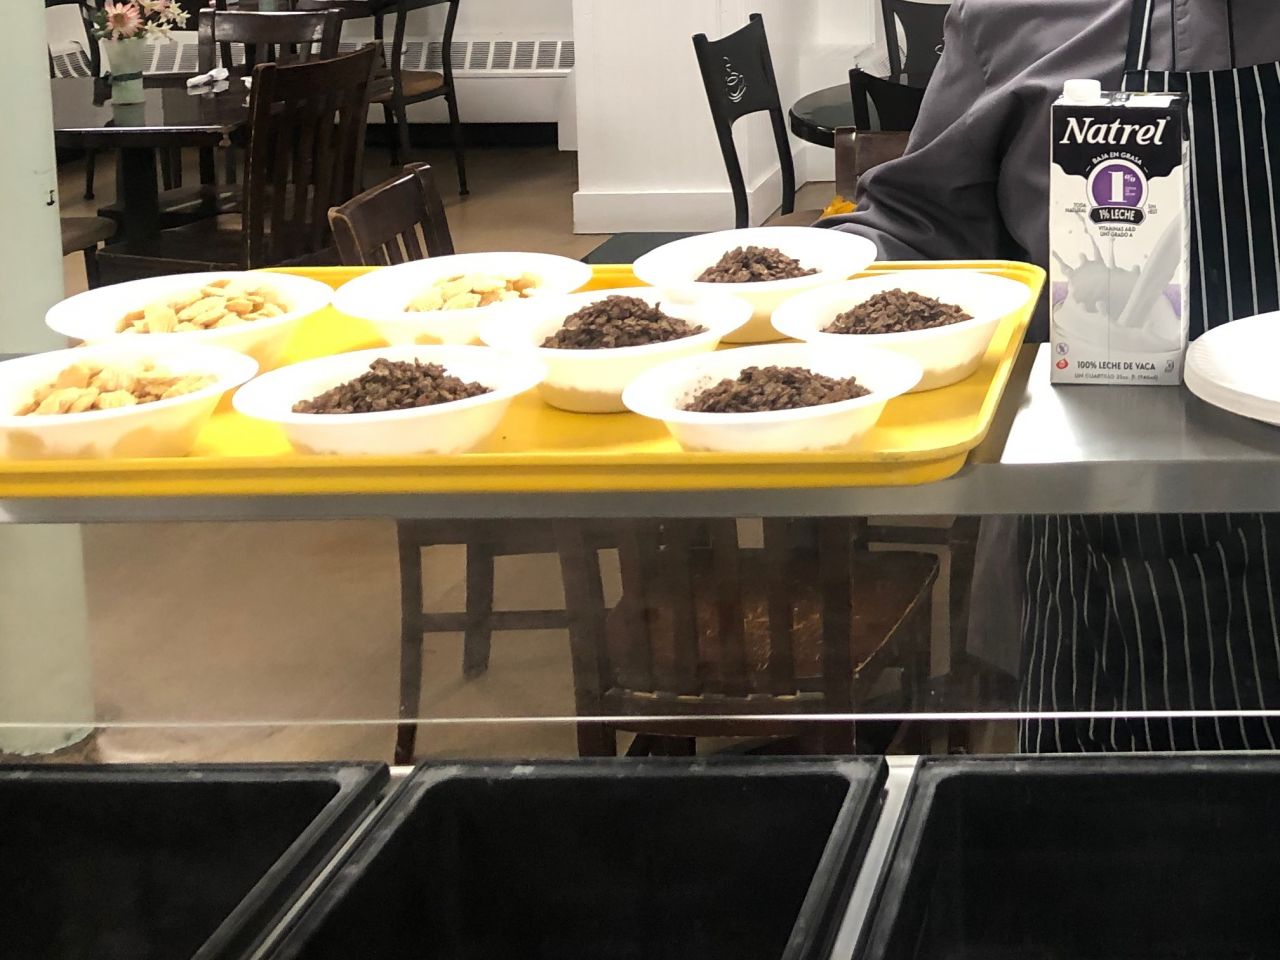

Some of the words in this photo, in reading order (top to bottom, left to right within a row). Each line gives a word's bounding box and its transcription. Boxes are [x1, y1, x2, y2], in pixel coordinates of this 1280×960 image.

[1059, 117, 1167, 145] Natrel
[1092, 153, 1109, 165] BAJA
[1120, 151, 1142, 166] GRASA
[1099, 209, 1110, 220] 1%
[1111, 209, 1136, 221] LECHE
[1077, 360, 1097, 369] 100%
[1098, 361, 1121, 370] LECHE
[1123, 361, 1133, 370] DE
[1134, 362, 1156, 371] VACA
